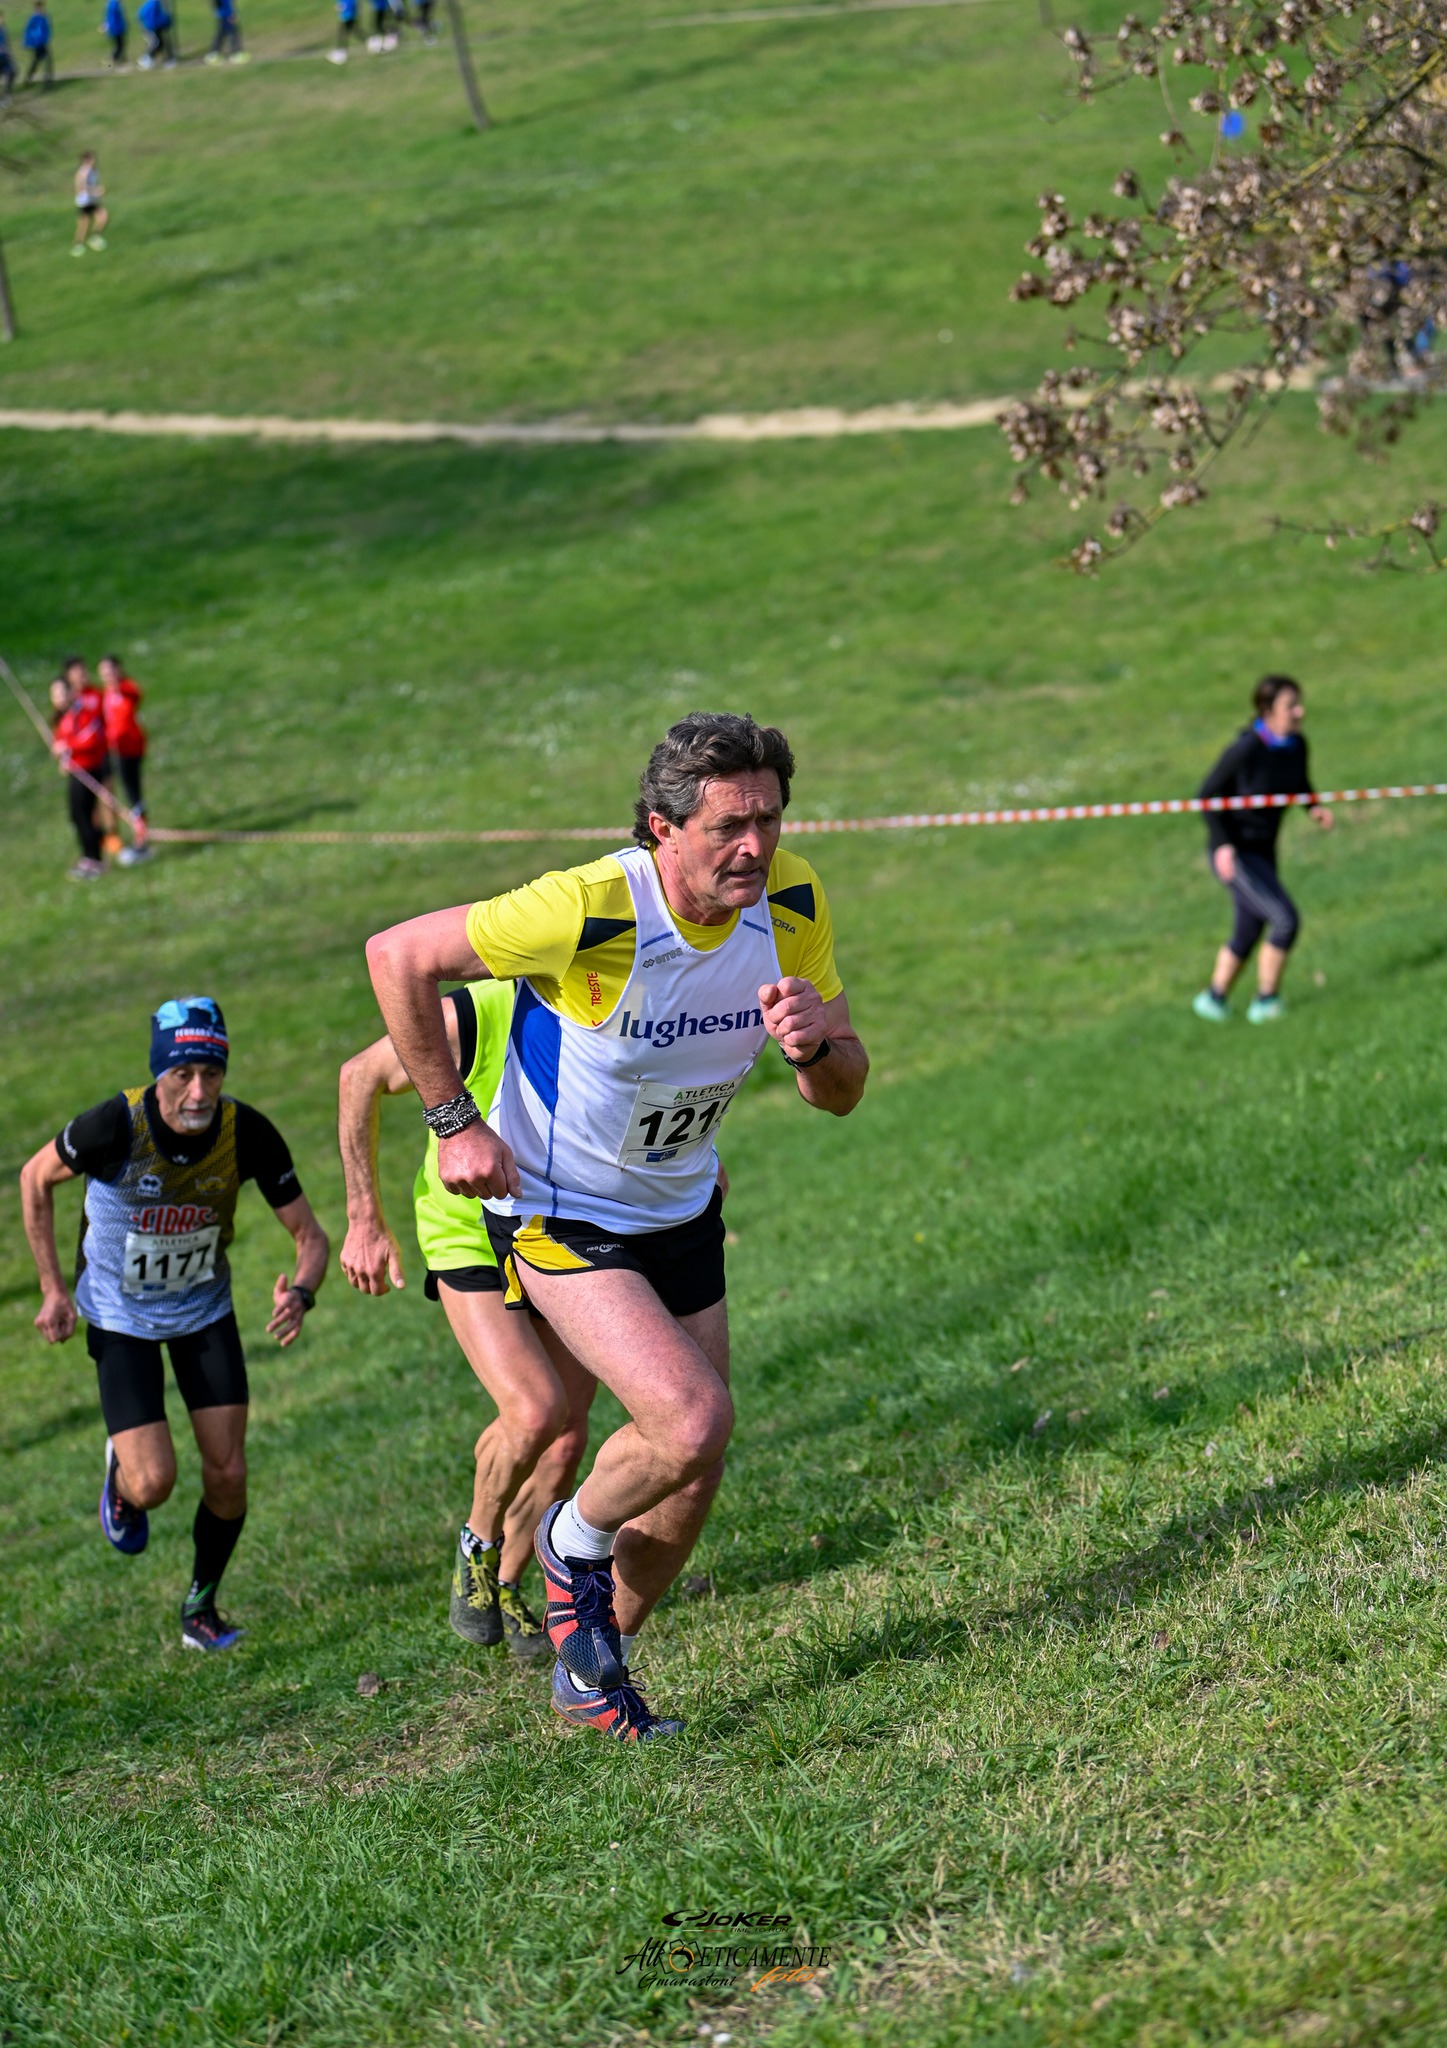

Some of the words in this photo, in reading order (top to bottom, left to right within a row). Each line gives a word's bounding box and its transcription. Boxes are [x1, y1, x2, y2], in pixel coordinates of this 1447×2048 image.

[587, 971, 602, 1007] TRIESTE
[619, 1008, 764, 1048] lughesin
[674, 1081, 735, 1101] ATLETICA
[638, 1093, 733, 1147] 121
[132, 1243, 212, 1280] 1177
